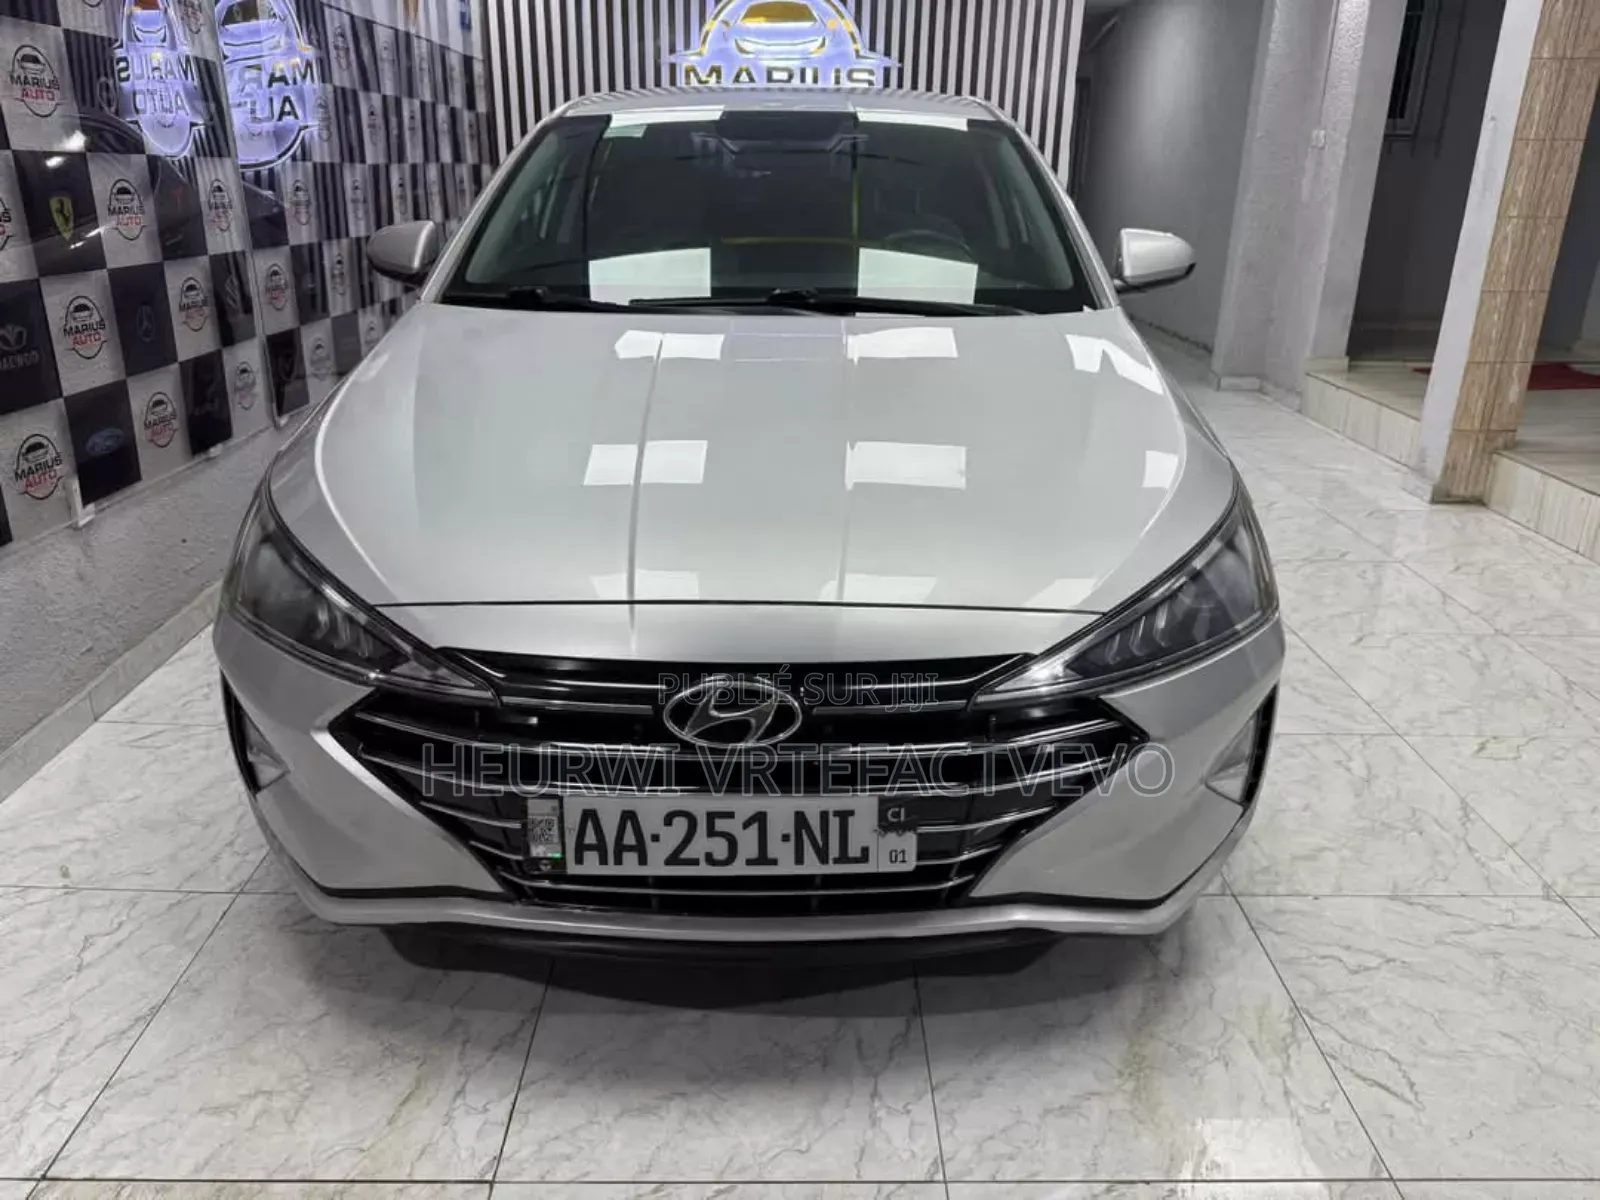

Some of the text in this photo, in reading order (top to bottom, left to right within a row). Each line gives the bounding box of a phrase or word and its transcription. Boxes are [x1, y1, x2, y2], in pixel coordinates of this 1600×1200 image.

[9, 73, 60, 91] MARIUS
[684, 65, 876, 85] MARIUS
[22, 87, 55, 101] AUTO
[107, 205, 145, 217] MARIUS
[63, 321, 105, 337] MARIUS
[72, 332, 102, 346] AUTO
[14, 455, 63, 482] MARIUS
[24, 469, 58, 488] AUTO
[887, 807, 905, 822] CI
[889, 848, 908, 864] 01
